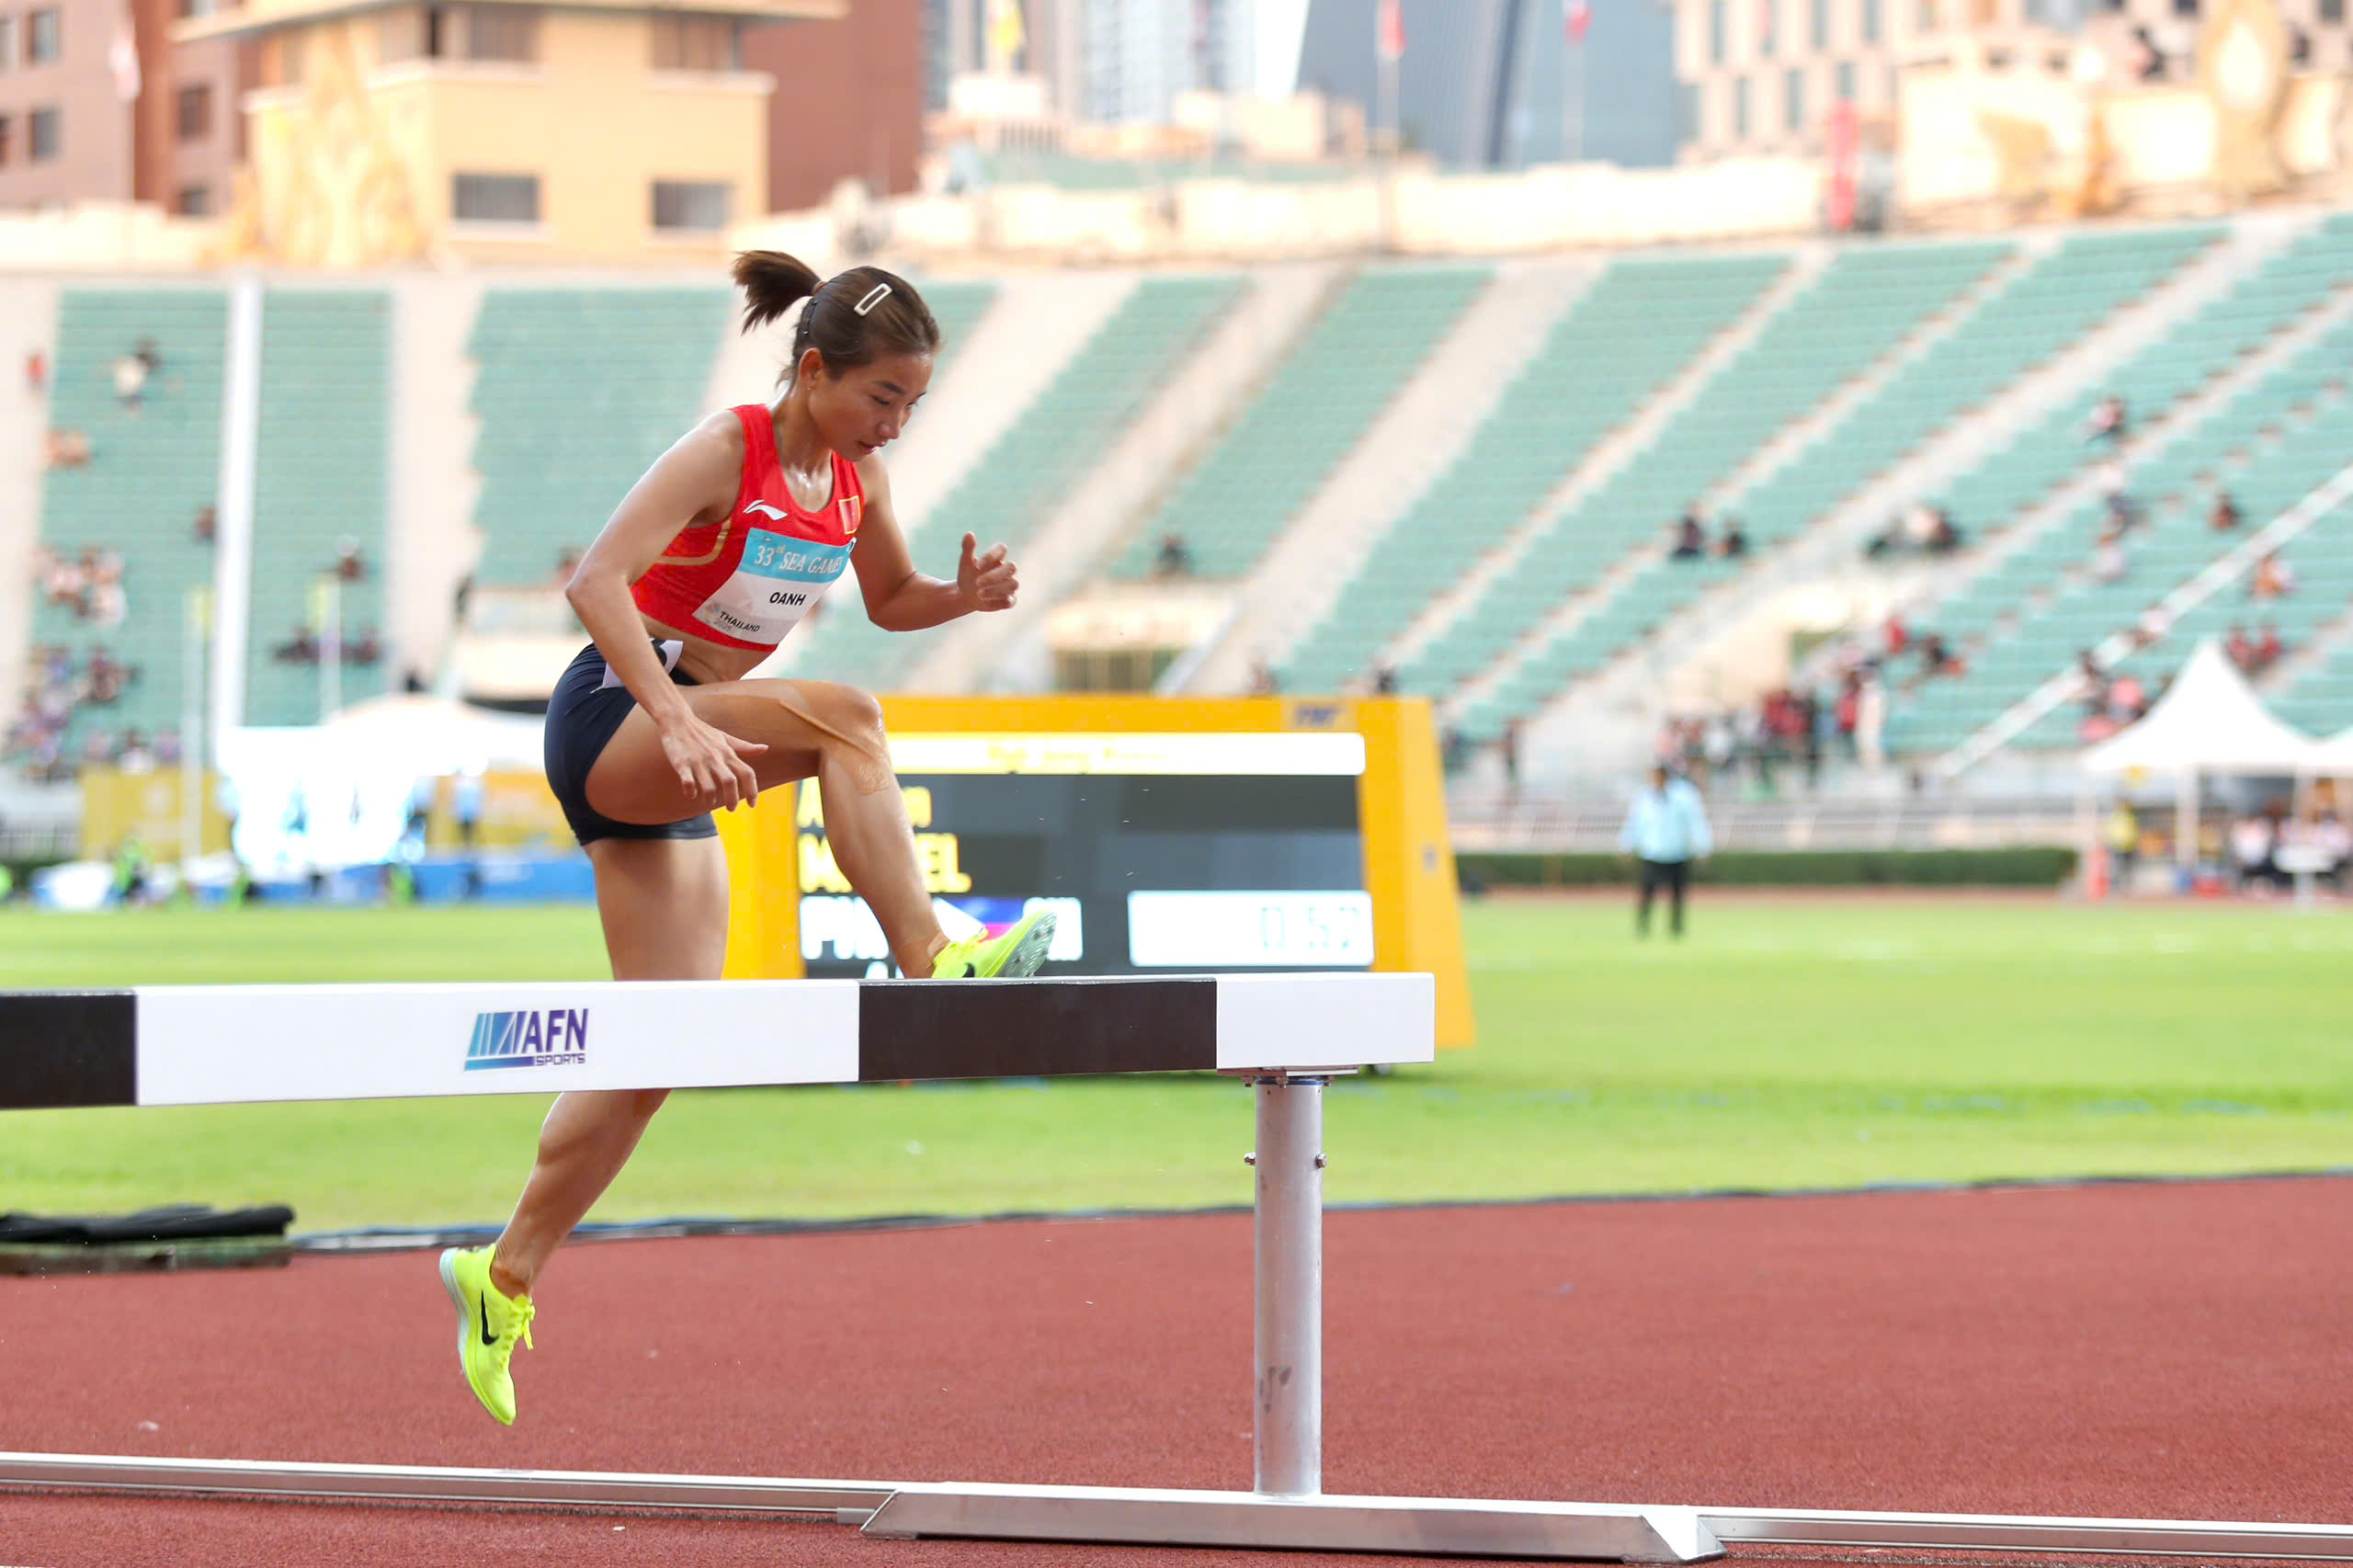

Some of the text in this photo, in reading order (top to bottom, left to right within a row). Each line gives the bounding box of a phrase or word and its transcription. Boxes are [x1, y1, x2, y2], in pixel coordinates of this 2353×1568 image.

[779, 551, 808, 572] SEA
[769, 591, 807, 607] OANH
[719, 610, 761, 632] THAILAND
[521, 1007, 589, 1054] AFN
[536, 1052, 586, 1067] SPORTS
